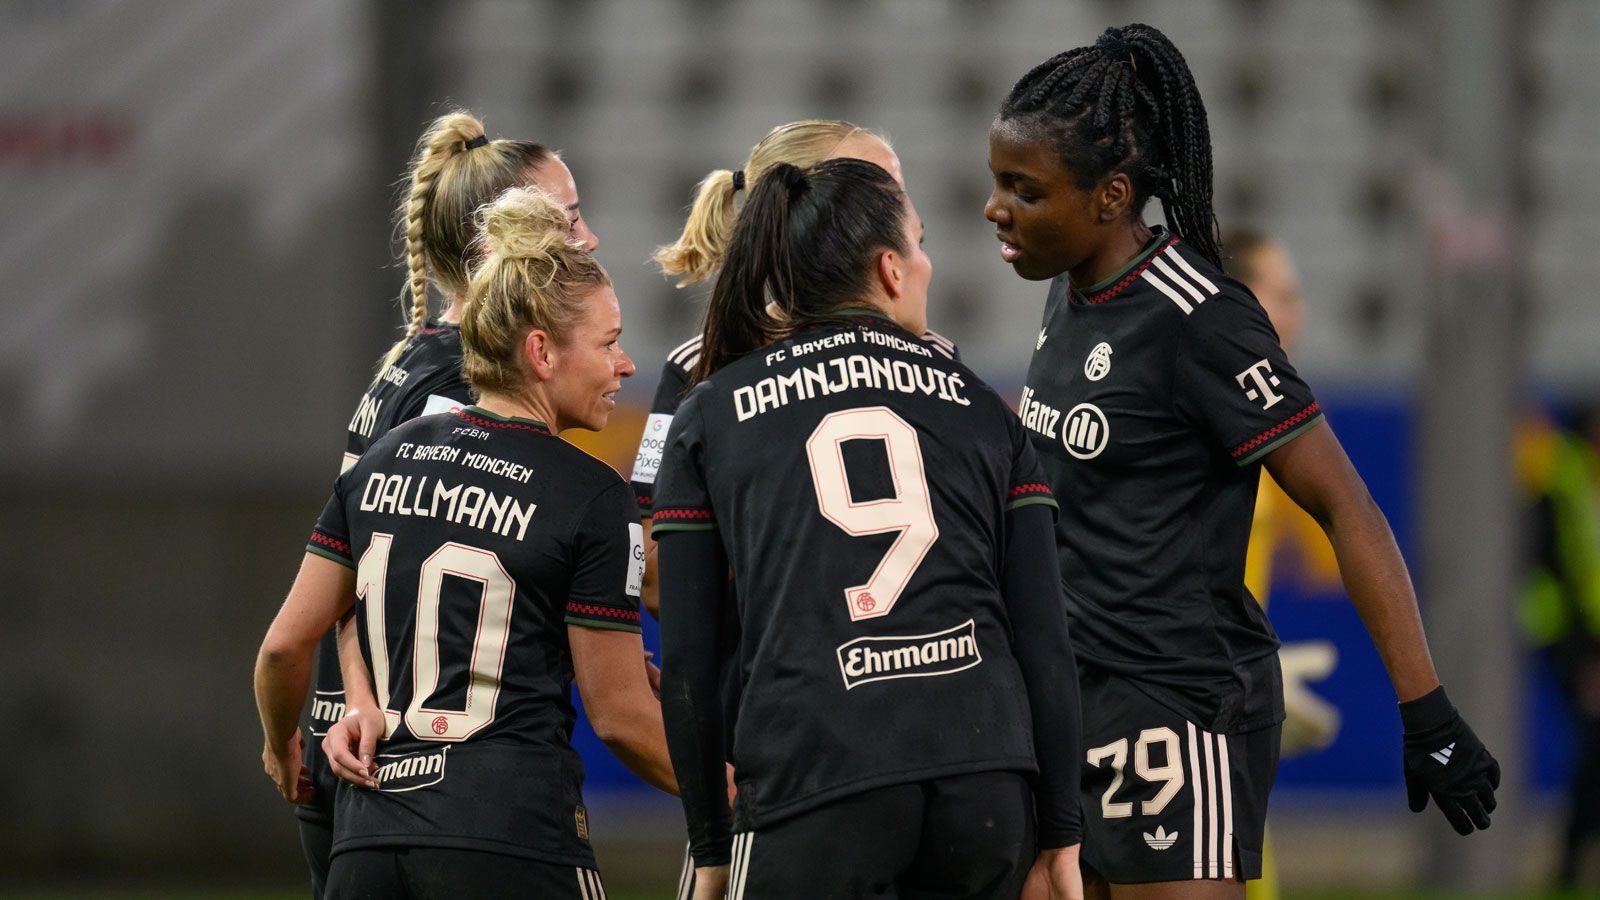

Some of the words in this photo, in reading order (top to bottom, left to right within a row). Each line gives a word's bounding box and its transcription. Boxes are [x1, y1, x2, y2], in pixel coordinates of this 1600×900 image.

[766, 350, 786, 366] FC
[792, 331, 856, 357] BAYERN
[733, 354, 971, 422] DAMNJANOVIĆ
[1235, 358, 1284, 411] T
[452, 427, 490, 441] FCBM
[395, 443, 413, 458] FC
[413, 445, 460, 462] BAYERN
[461, 451, 534, 484] MÜNCHEN
[360, 472, 537, 541] DALLMANN
[806, 406, 939, 622] 9
[356, 532, 516, 742] 10
[845, 634, 975, 677] Ehrmann
[377, 753, 443, 782] mann
[1087, 726, 1185, 819] 29
